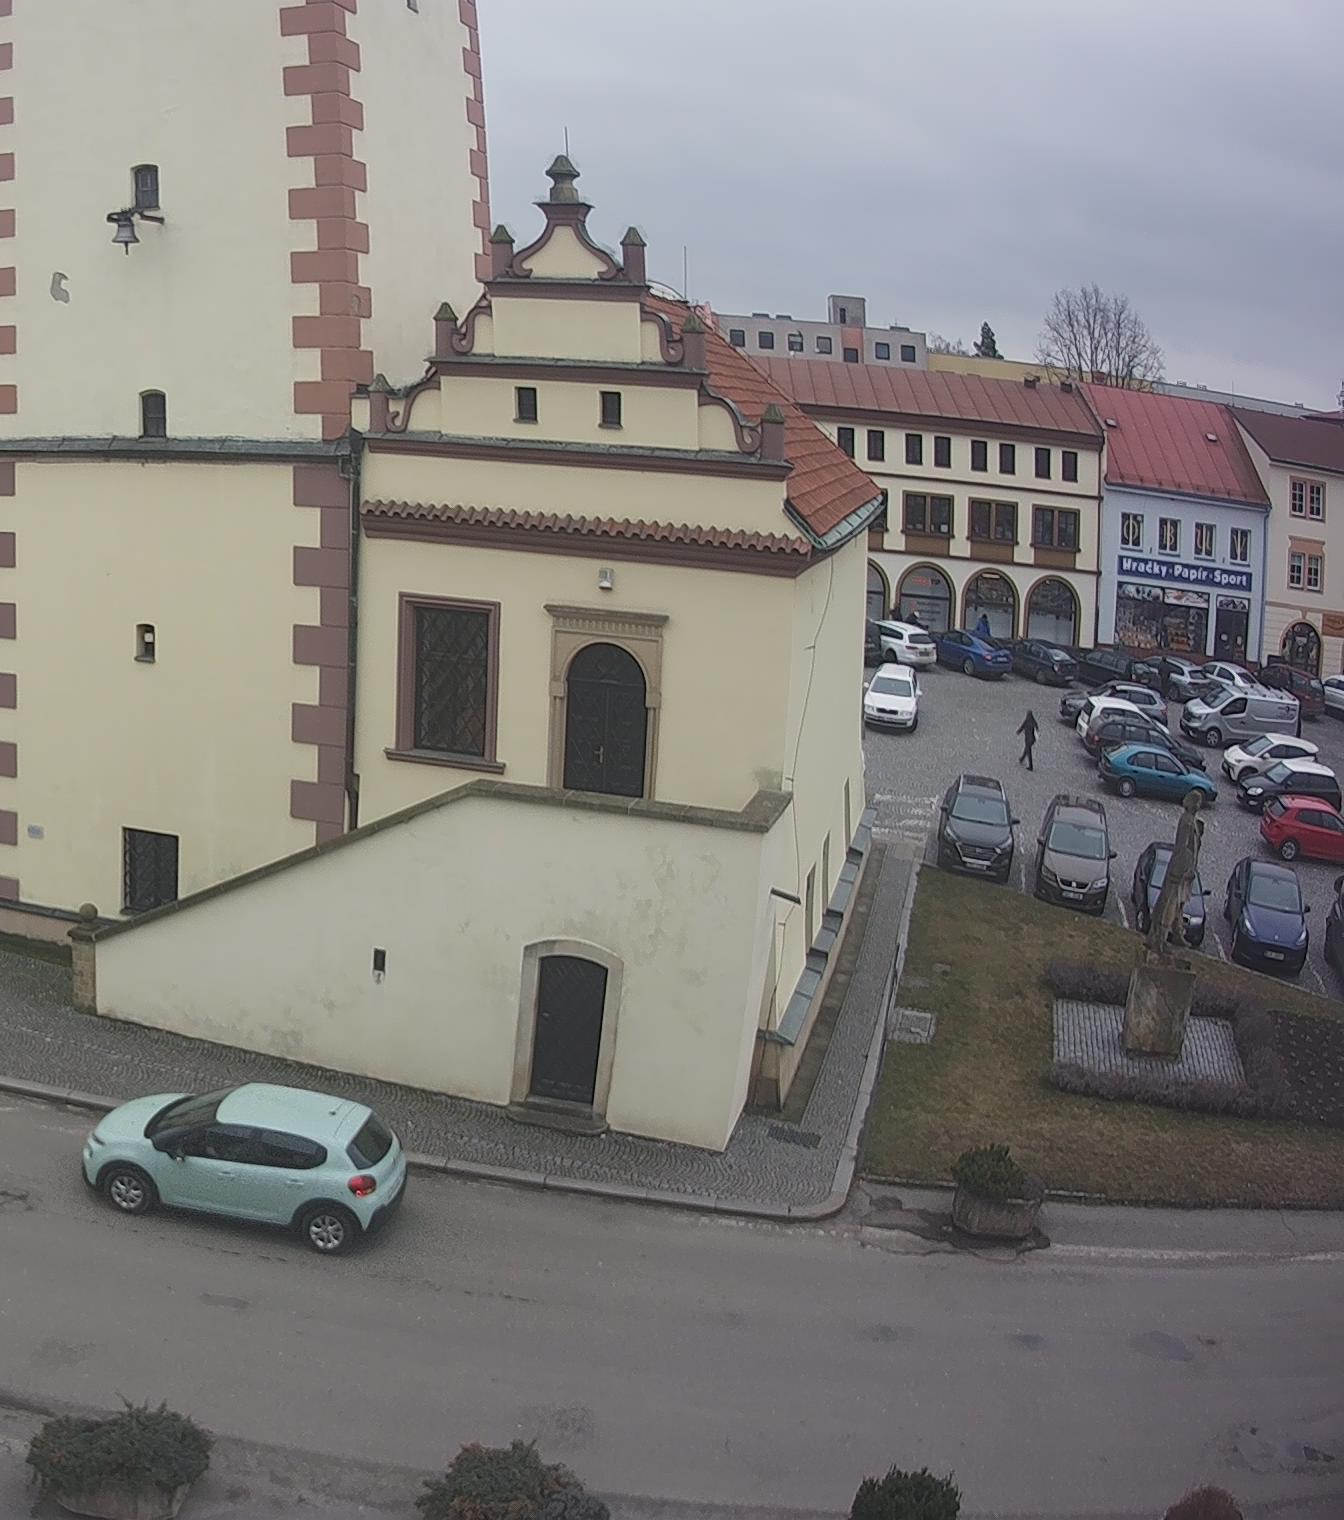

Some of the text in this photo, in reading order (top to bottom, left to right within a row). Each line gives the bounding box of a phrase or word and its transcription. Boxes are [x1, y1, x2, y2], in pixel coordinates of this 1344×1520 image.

[1122, 557, 1247, 586] Hračky Papír Sport
